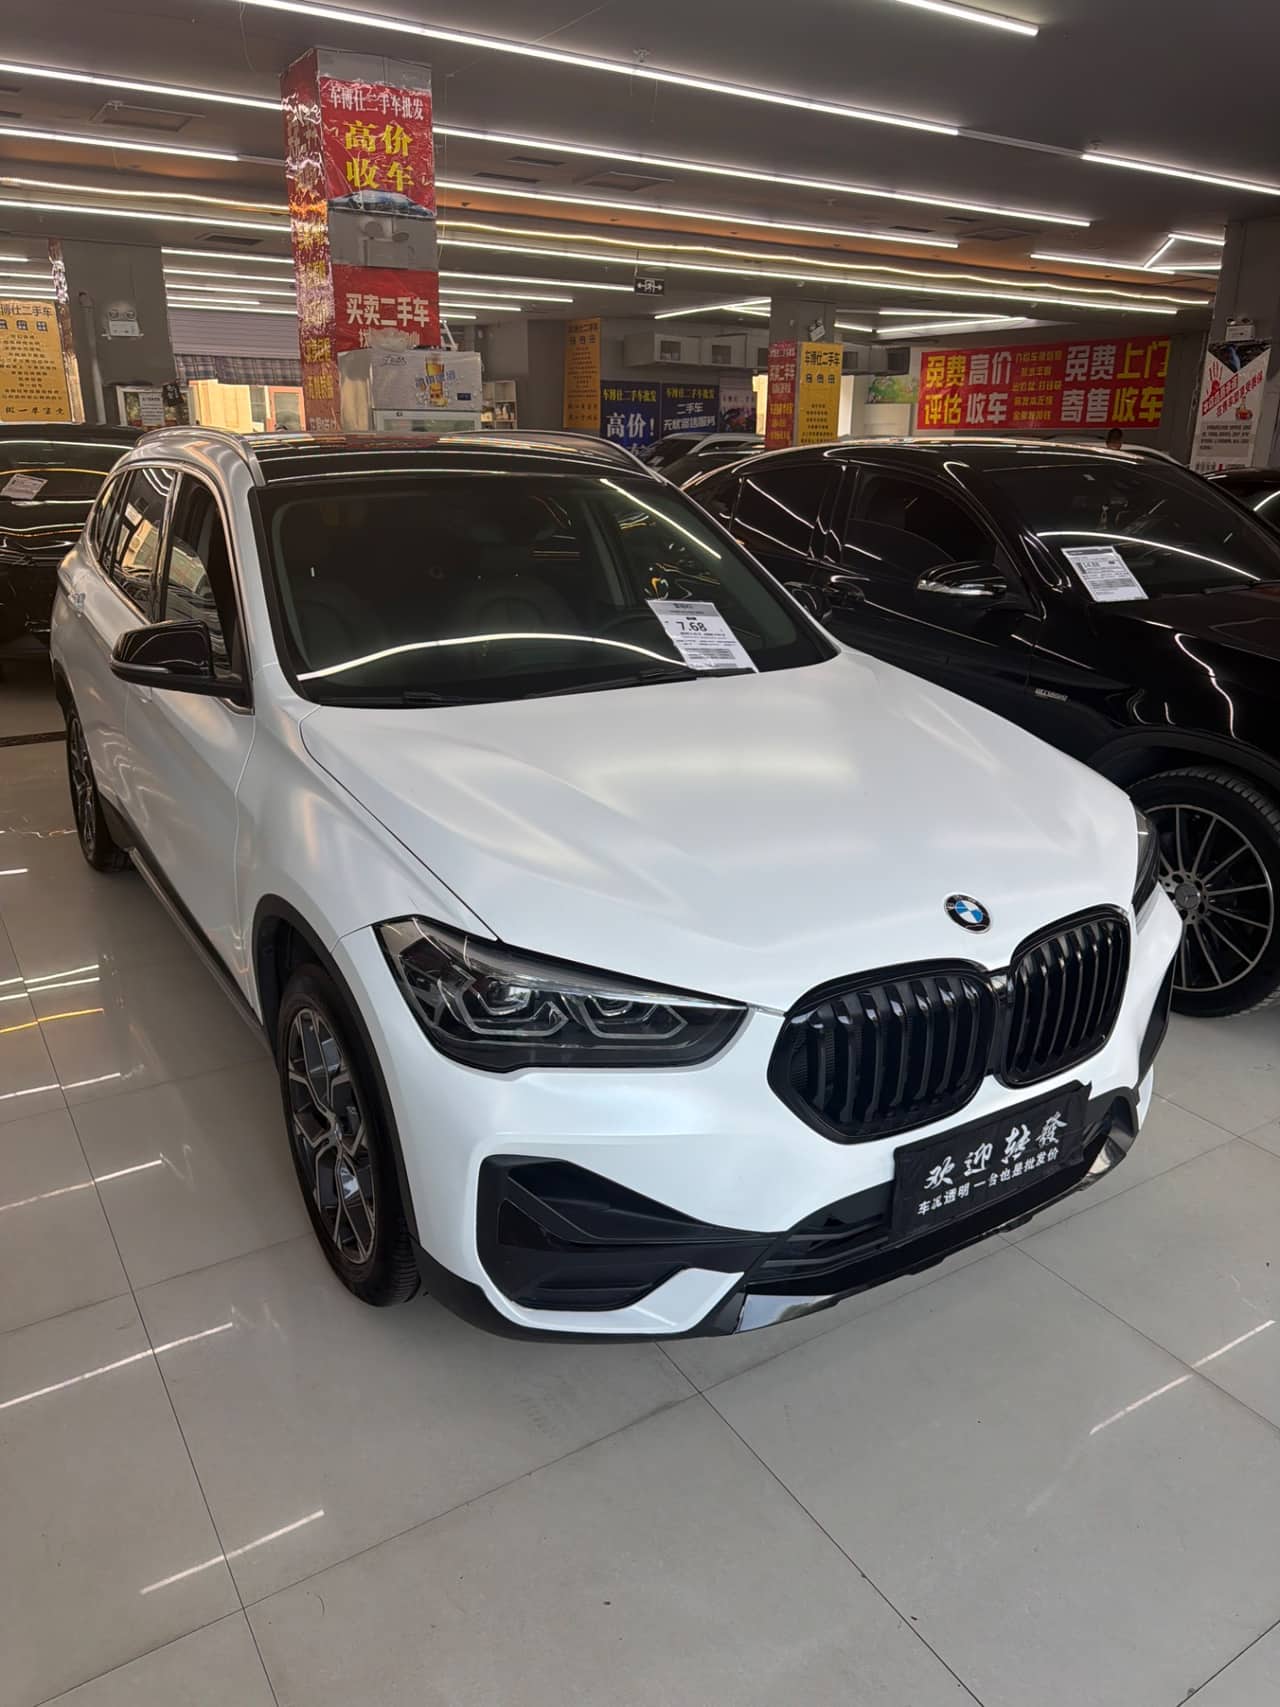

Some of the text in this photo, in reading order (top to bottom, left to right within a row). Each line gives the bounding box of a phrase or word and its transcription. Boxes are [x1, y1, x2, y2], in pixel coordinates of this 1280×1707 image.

[329, 84, 424, 121] 车博仕二手车批发
[343, 120, 414, 157] 高价
[345, 157, 415, 192] 收车
[345, 293, 430, 327] 买卖二手车
[676, 621, 708, 632] 7.68
